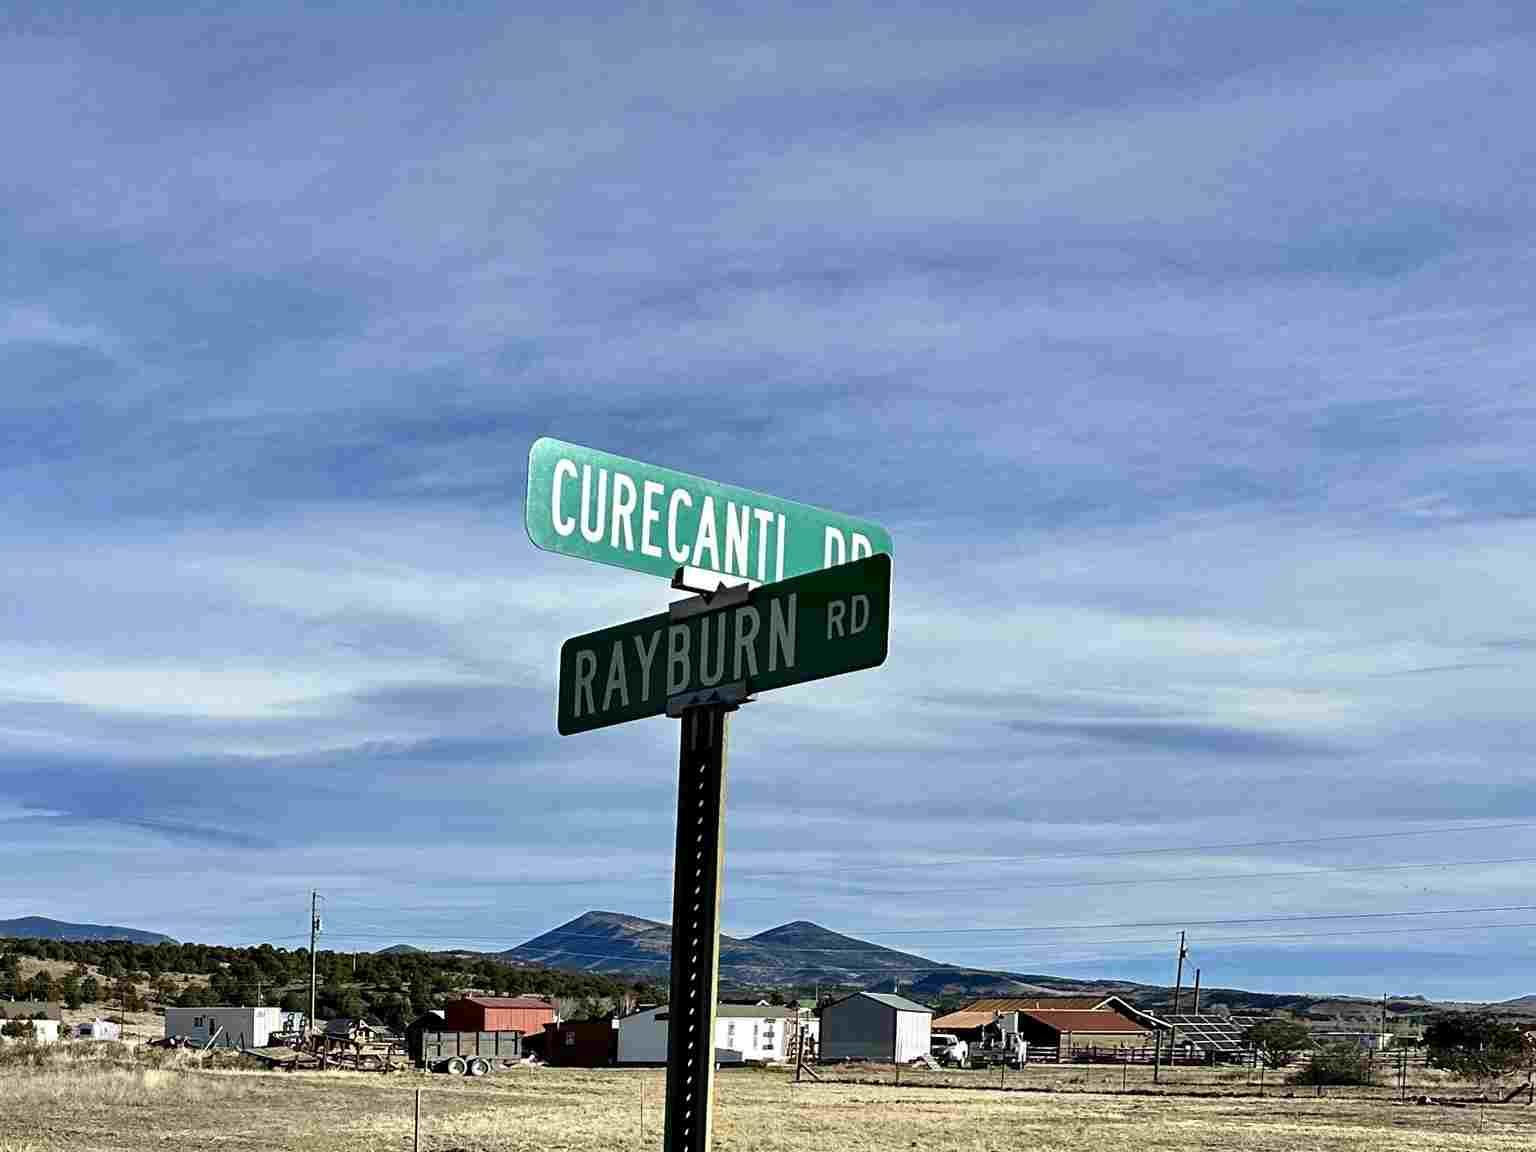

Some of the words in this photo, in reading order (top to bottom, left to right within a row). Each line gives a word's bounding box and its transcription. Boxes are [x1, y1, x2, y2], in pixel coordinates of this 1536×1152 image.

[551, 458, 786, 582] CURECANTI
[573, 593, 797, 718] RAYBURN
[827, 594, 870, 640] RD
